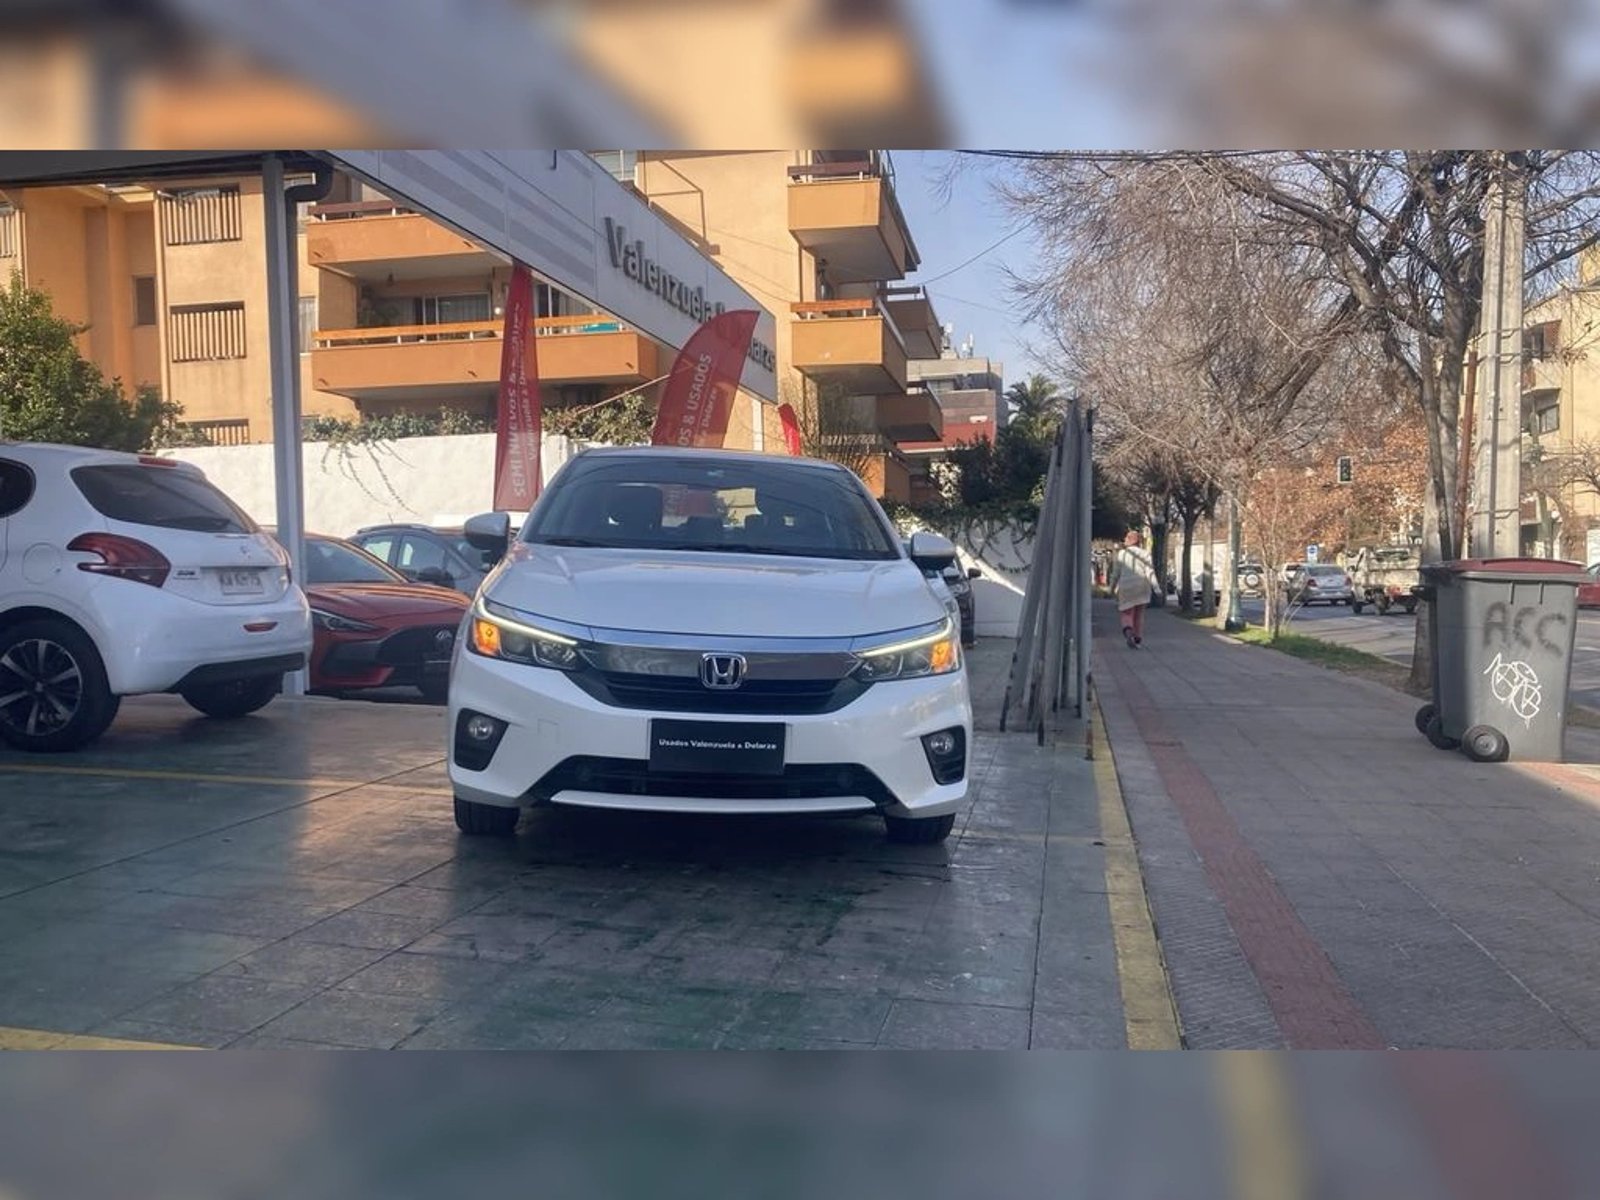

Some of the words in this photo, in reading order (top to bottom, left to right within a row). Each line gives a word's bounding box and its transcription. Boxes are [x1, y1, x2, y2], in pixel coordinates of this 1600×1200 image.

[604, 216, 713, 325] Valenzuela
[687, 353, 712, 411] USADOS
[510, 459, 526, 498] SEMI
[658, 738, 689, 748] Usados
[690, 739, 735, 750] Valenzuela
[744, 741, 777, 751] Delarze
